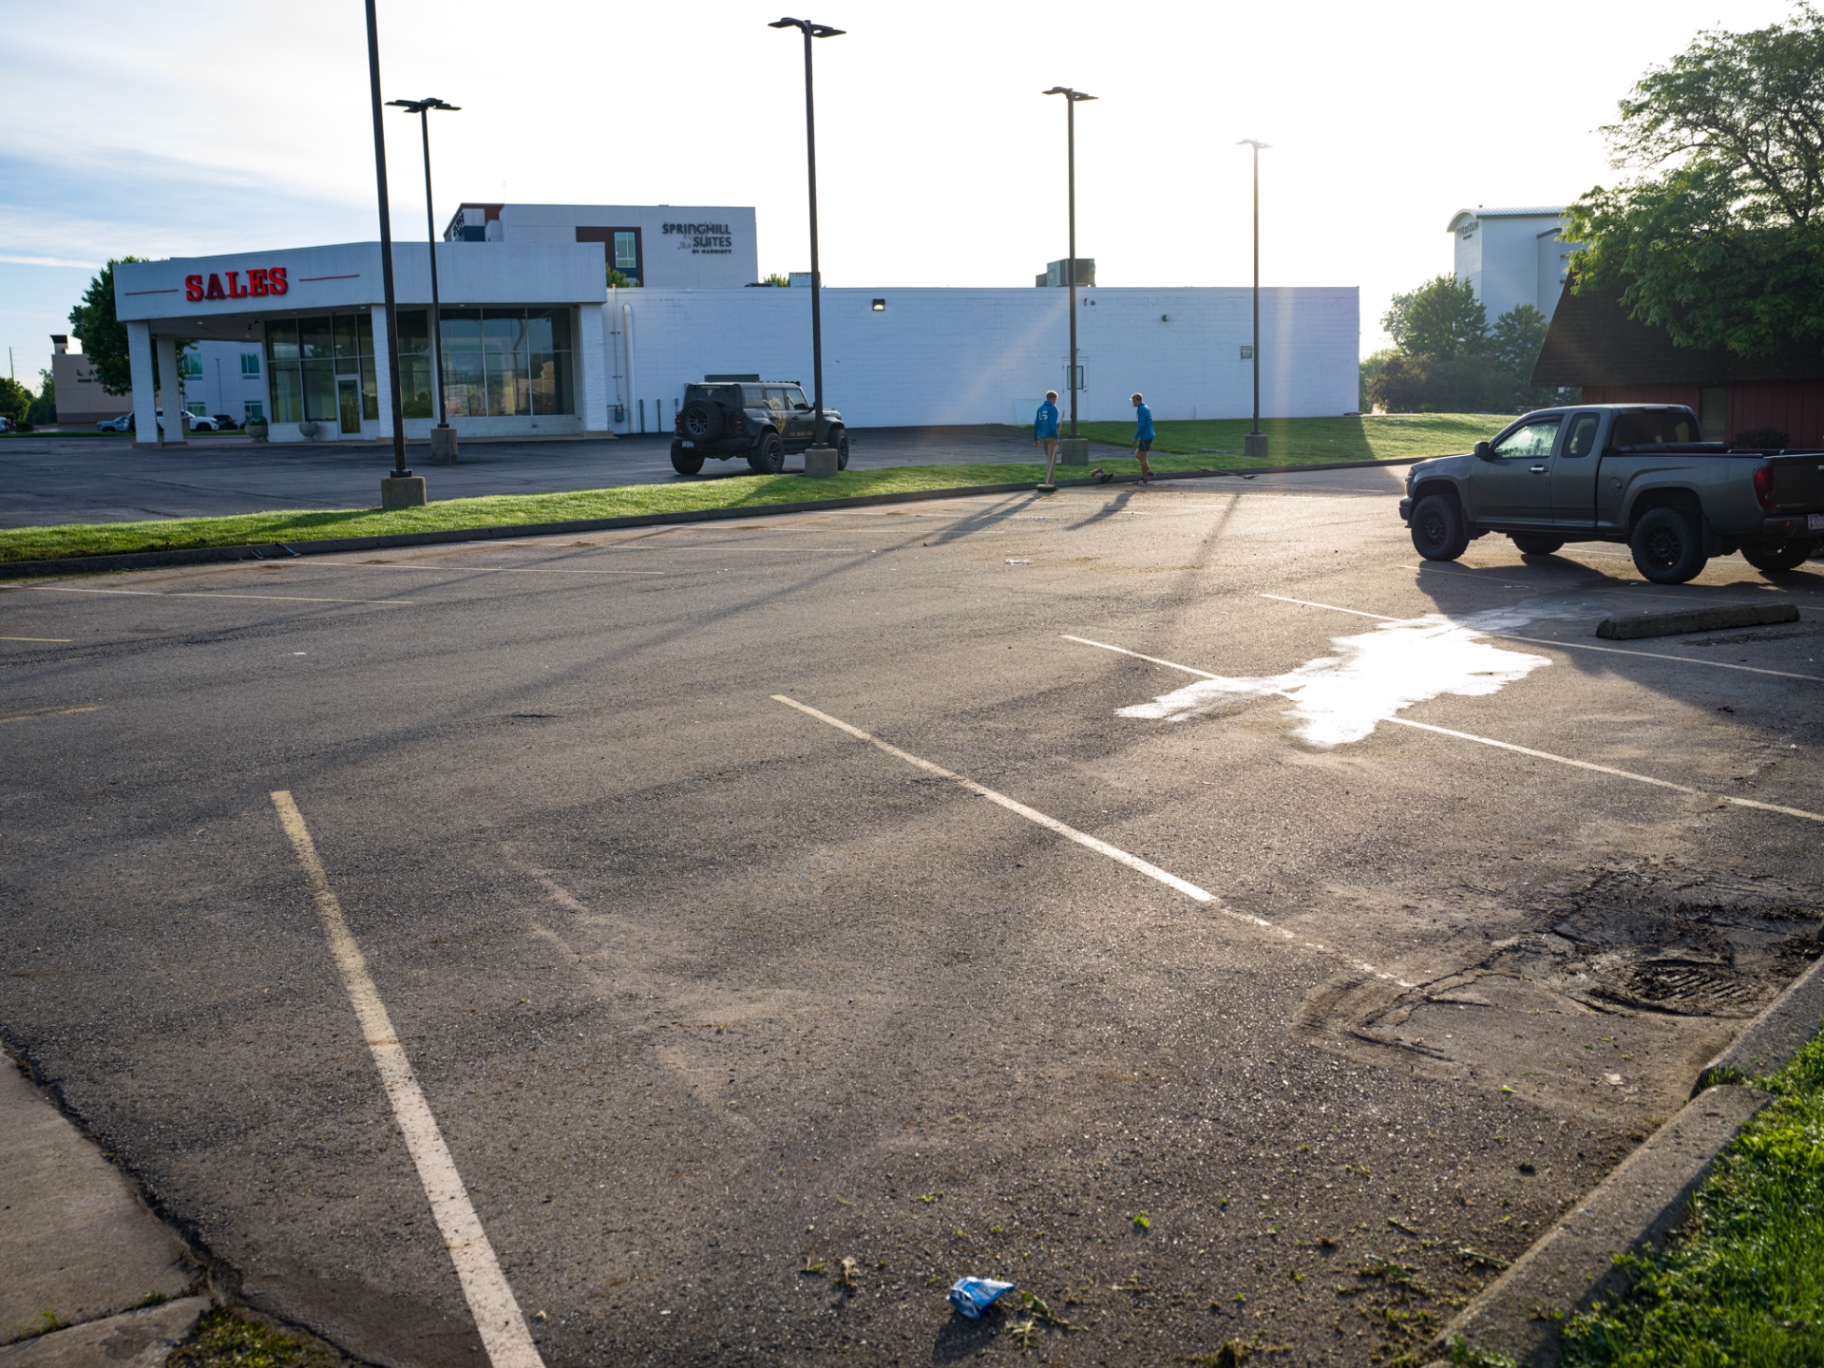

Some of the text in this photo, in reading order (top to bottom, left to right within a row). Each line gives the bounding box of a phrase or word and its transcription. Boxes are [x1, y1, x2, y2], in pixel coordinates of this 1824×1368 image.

[662, 223, 731, 235] SPRINGHILL
[693, 236, 732, 248] SUITES
[185, 266, 289, 302] SALES
